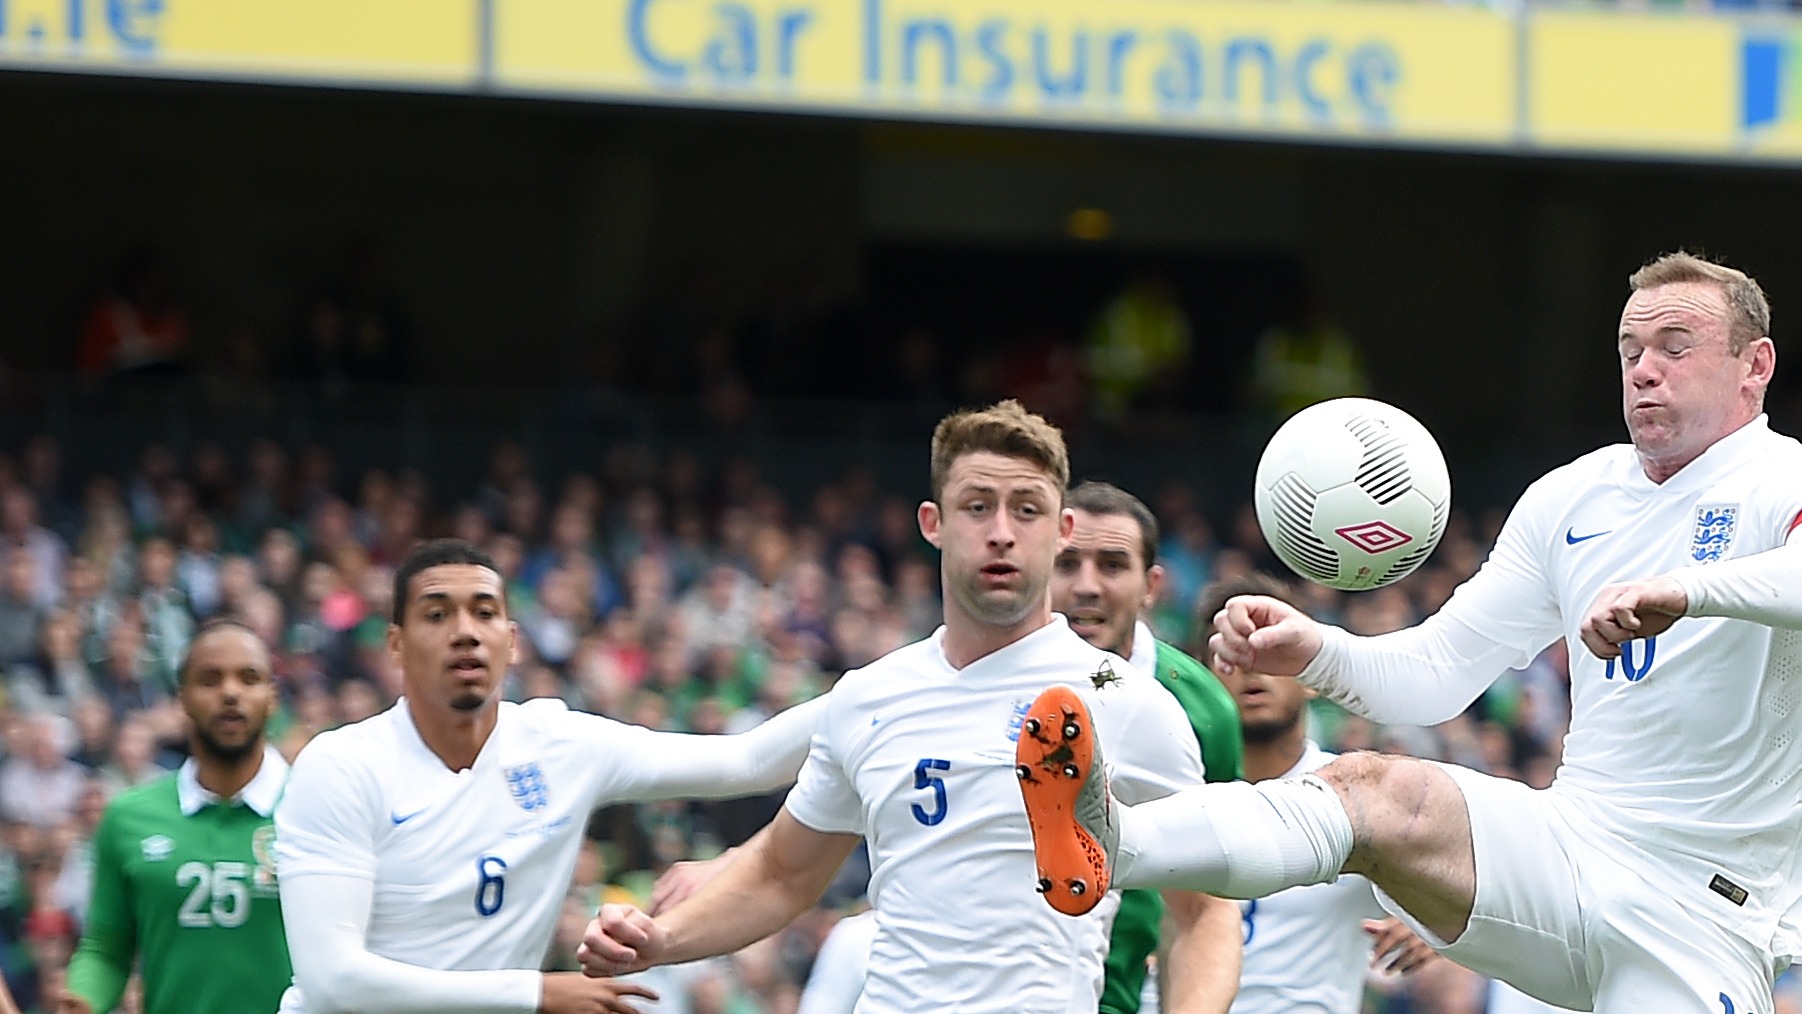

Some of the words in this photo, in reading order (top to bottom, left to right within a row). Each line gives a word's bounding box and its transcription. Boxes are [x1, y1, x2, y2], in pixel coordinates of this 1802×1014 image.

[624, 0, 813, 84] Car
[863, 0, 1404, 132] Insurance
[911, 758, 951, 826] 5
[178, 861, 251, 928] 25
[473, 857, 507, 917] 6
